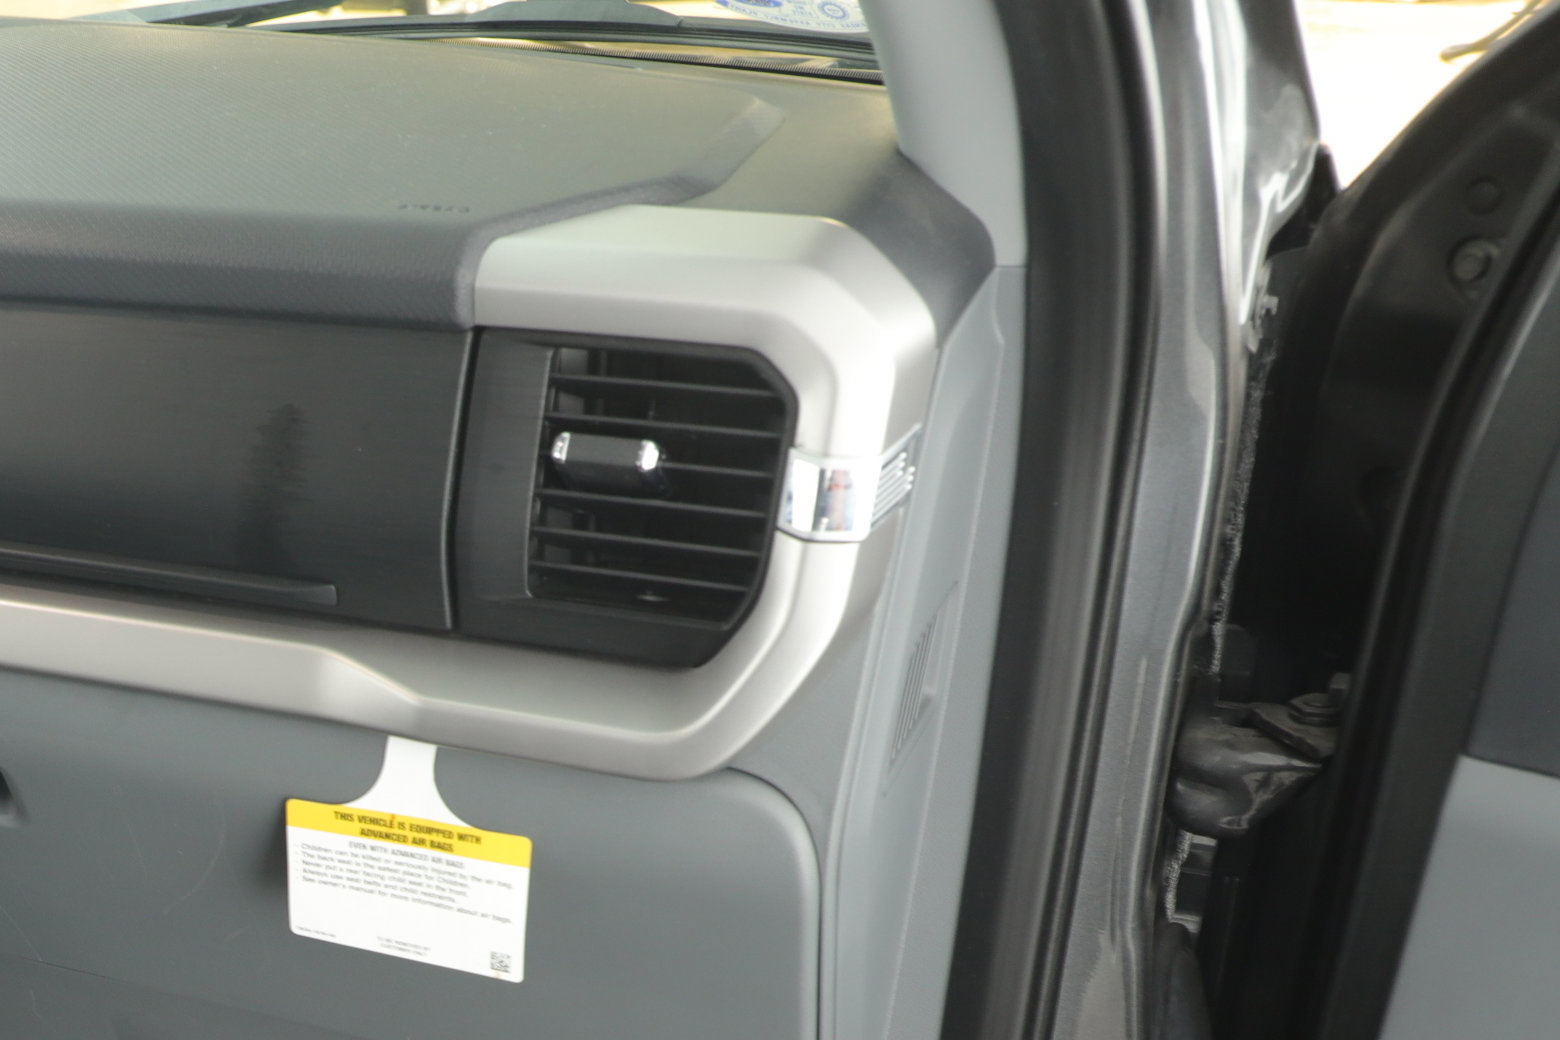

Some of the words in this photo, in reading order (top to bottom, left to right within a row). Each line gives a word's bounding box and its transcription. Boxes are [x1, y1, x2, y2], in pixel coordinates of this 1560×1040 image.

[334, 810, 354, 822] THIS
[357, 813, 394, 829] VEHICLE
[397, 820, 406, 831] IS
[409, 822, 453, 839] EQUIPPED
[457, 831, 481, 845] WITH
[360, 826, 407, 843] ADVANCED
[411, 835, 426, 847] AIR
[430, 839, 453, 852] BAGS
[369, 843, 387, 854] WITH
[391, 848, 428, 862] ADVANCED
